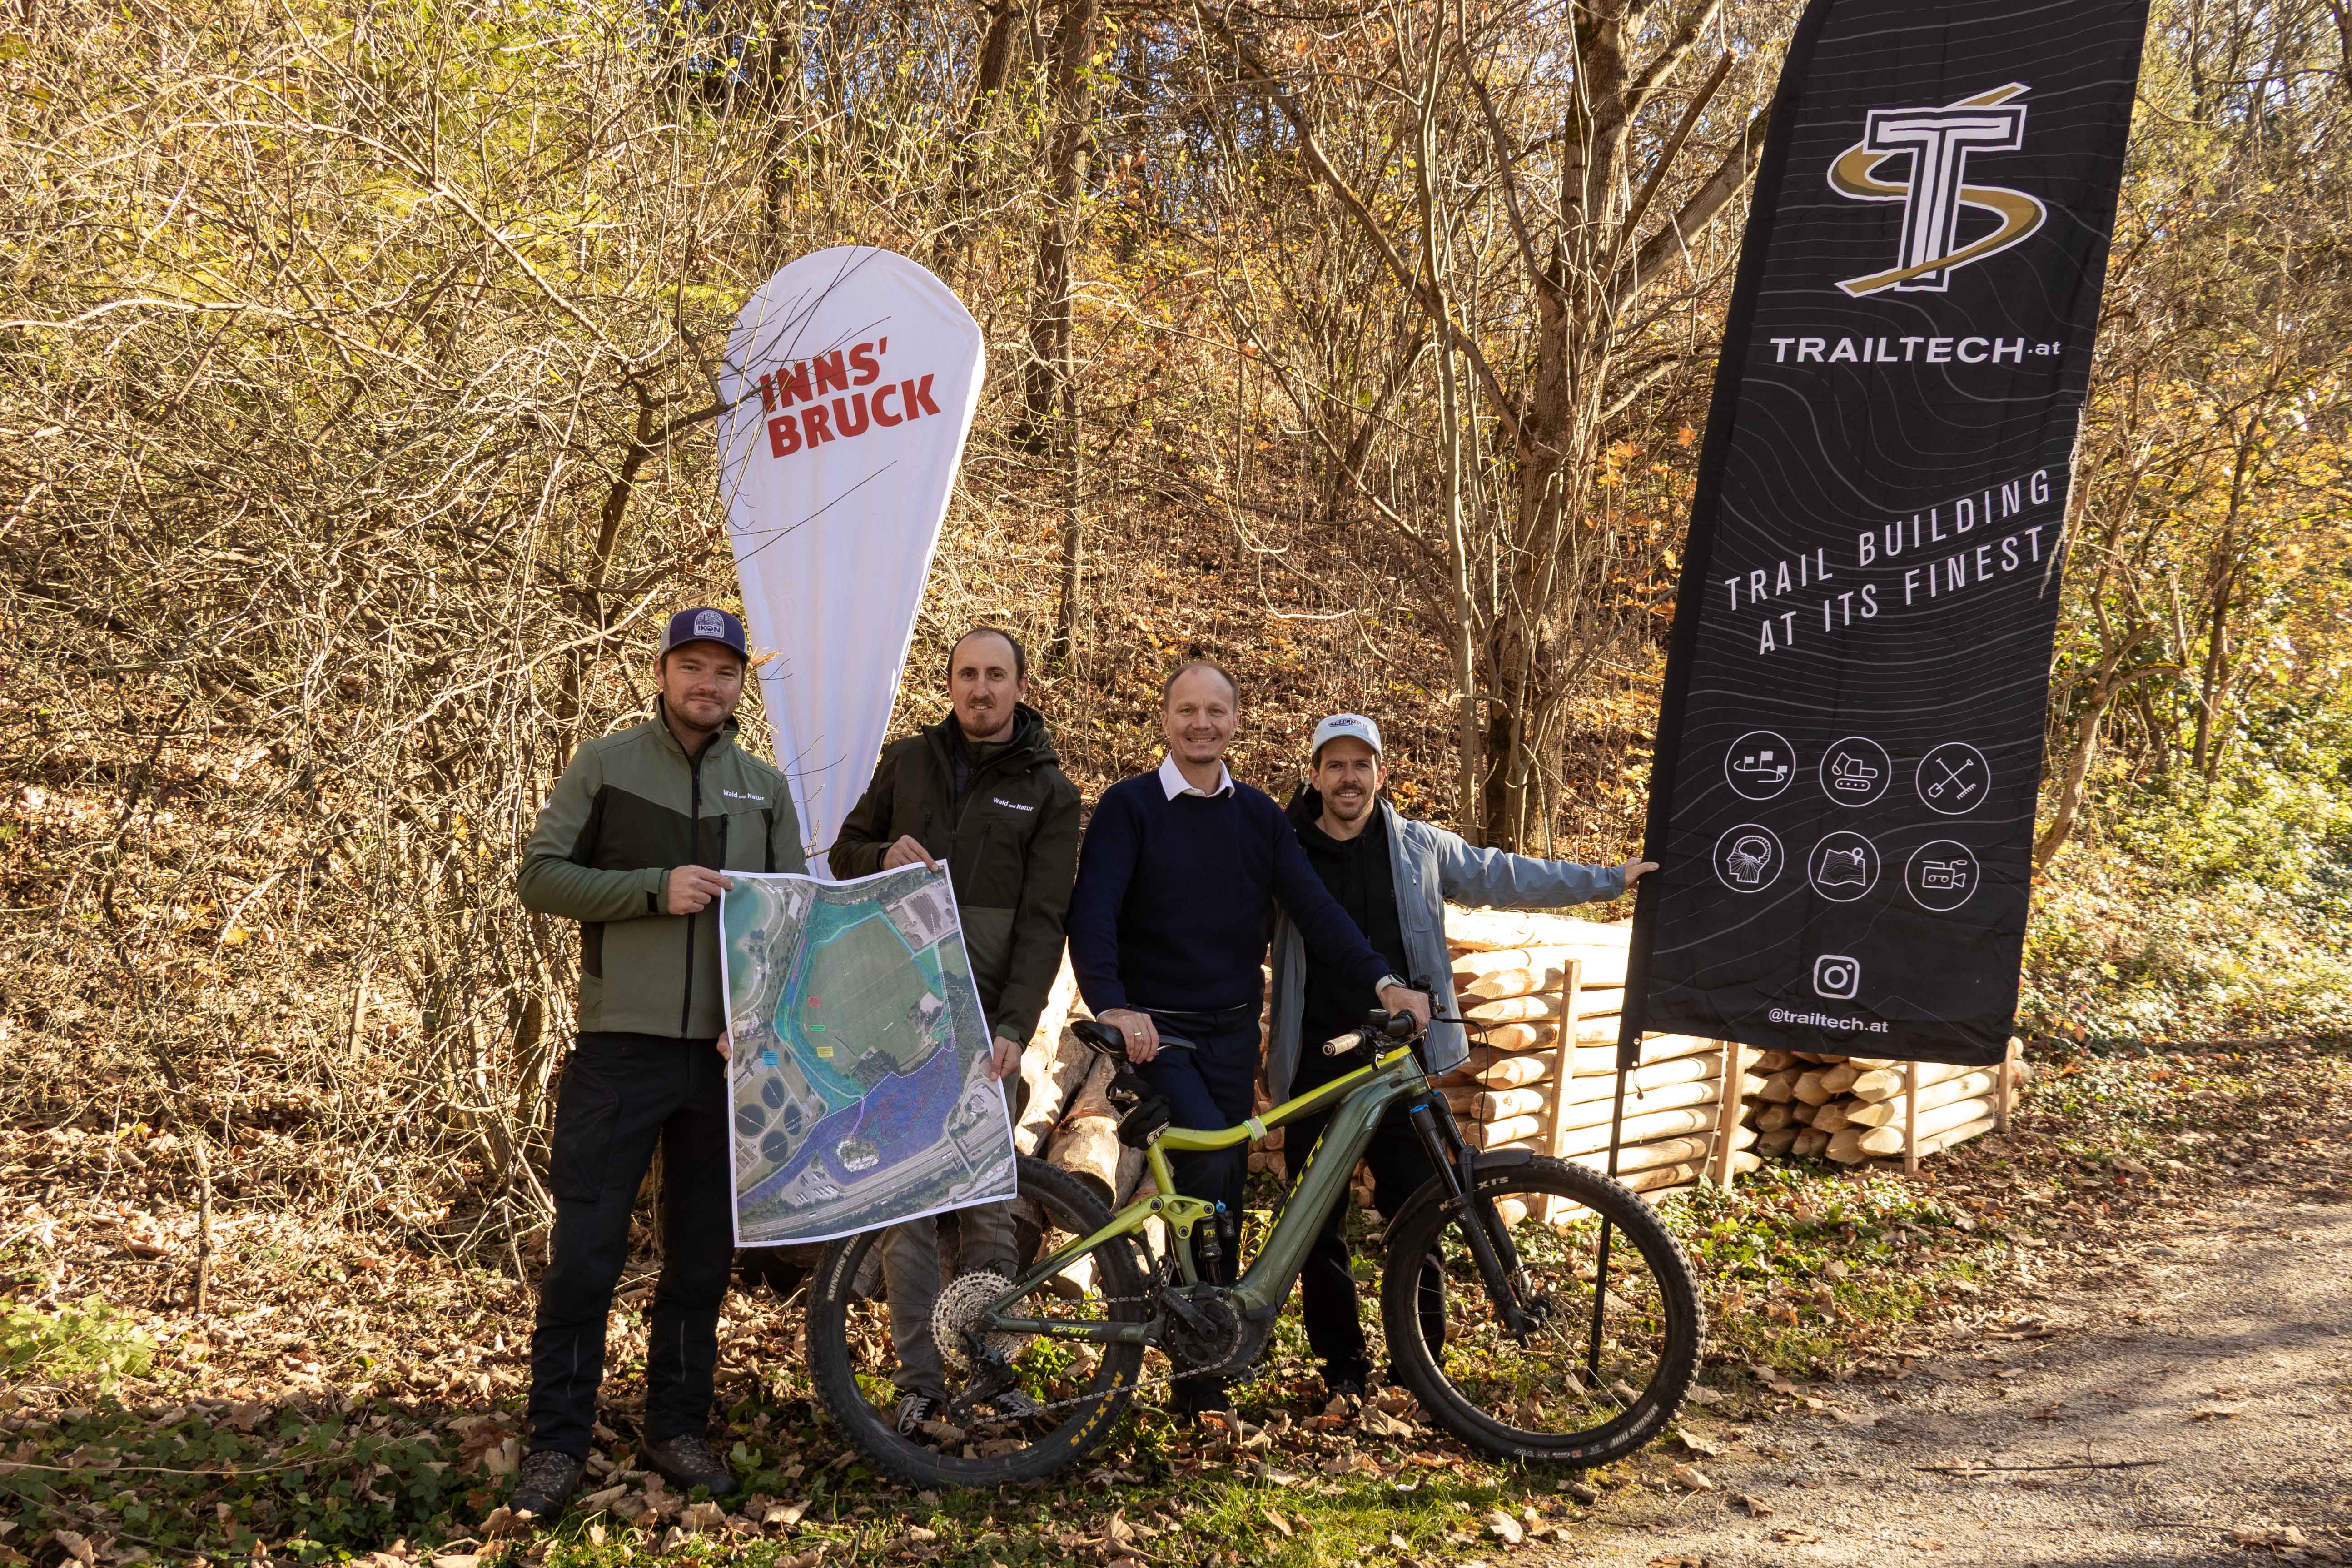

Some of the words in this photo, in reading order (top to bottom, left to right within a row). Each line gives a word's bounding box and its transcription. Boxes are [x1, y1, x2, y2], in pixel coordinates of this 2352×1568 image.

[759, 336, 888, 413] INNS'
[767, 373, 941, 459] BRUCK
[1725, 548, 1833, 611] TRAIL
[1859, 469, 2049, 567] BUILDING
[1759, 610, 1797, 655] AT
[1824, 583, 1878, 633] ITS
[1904, 525, 2043, 606] FINEST
[697, 625, 721, 633] IKON
[723, 789, 738, 798] Wald
[747, 792, 765, 801] Natur
[993, 796, 1009, 806] Wald
[1016, 803, 1034, 811] Natur
[1768, 1008, 1889, 1034] @trailtech.at
[1439, 1176, 1509, 1213] MXIS
[1051, 1325, 1094, 1335] GIANT
